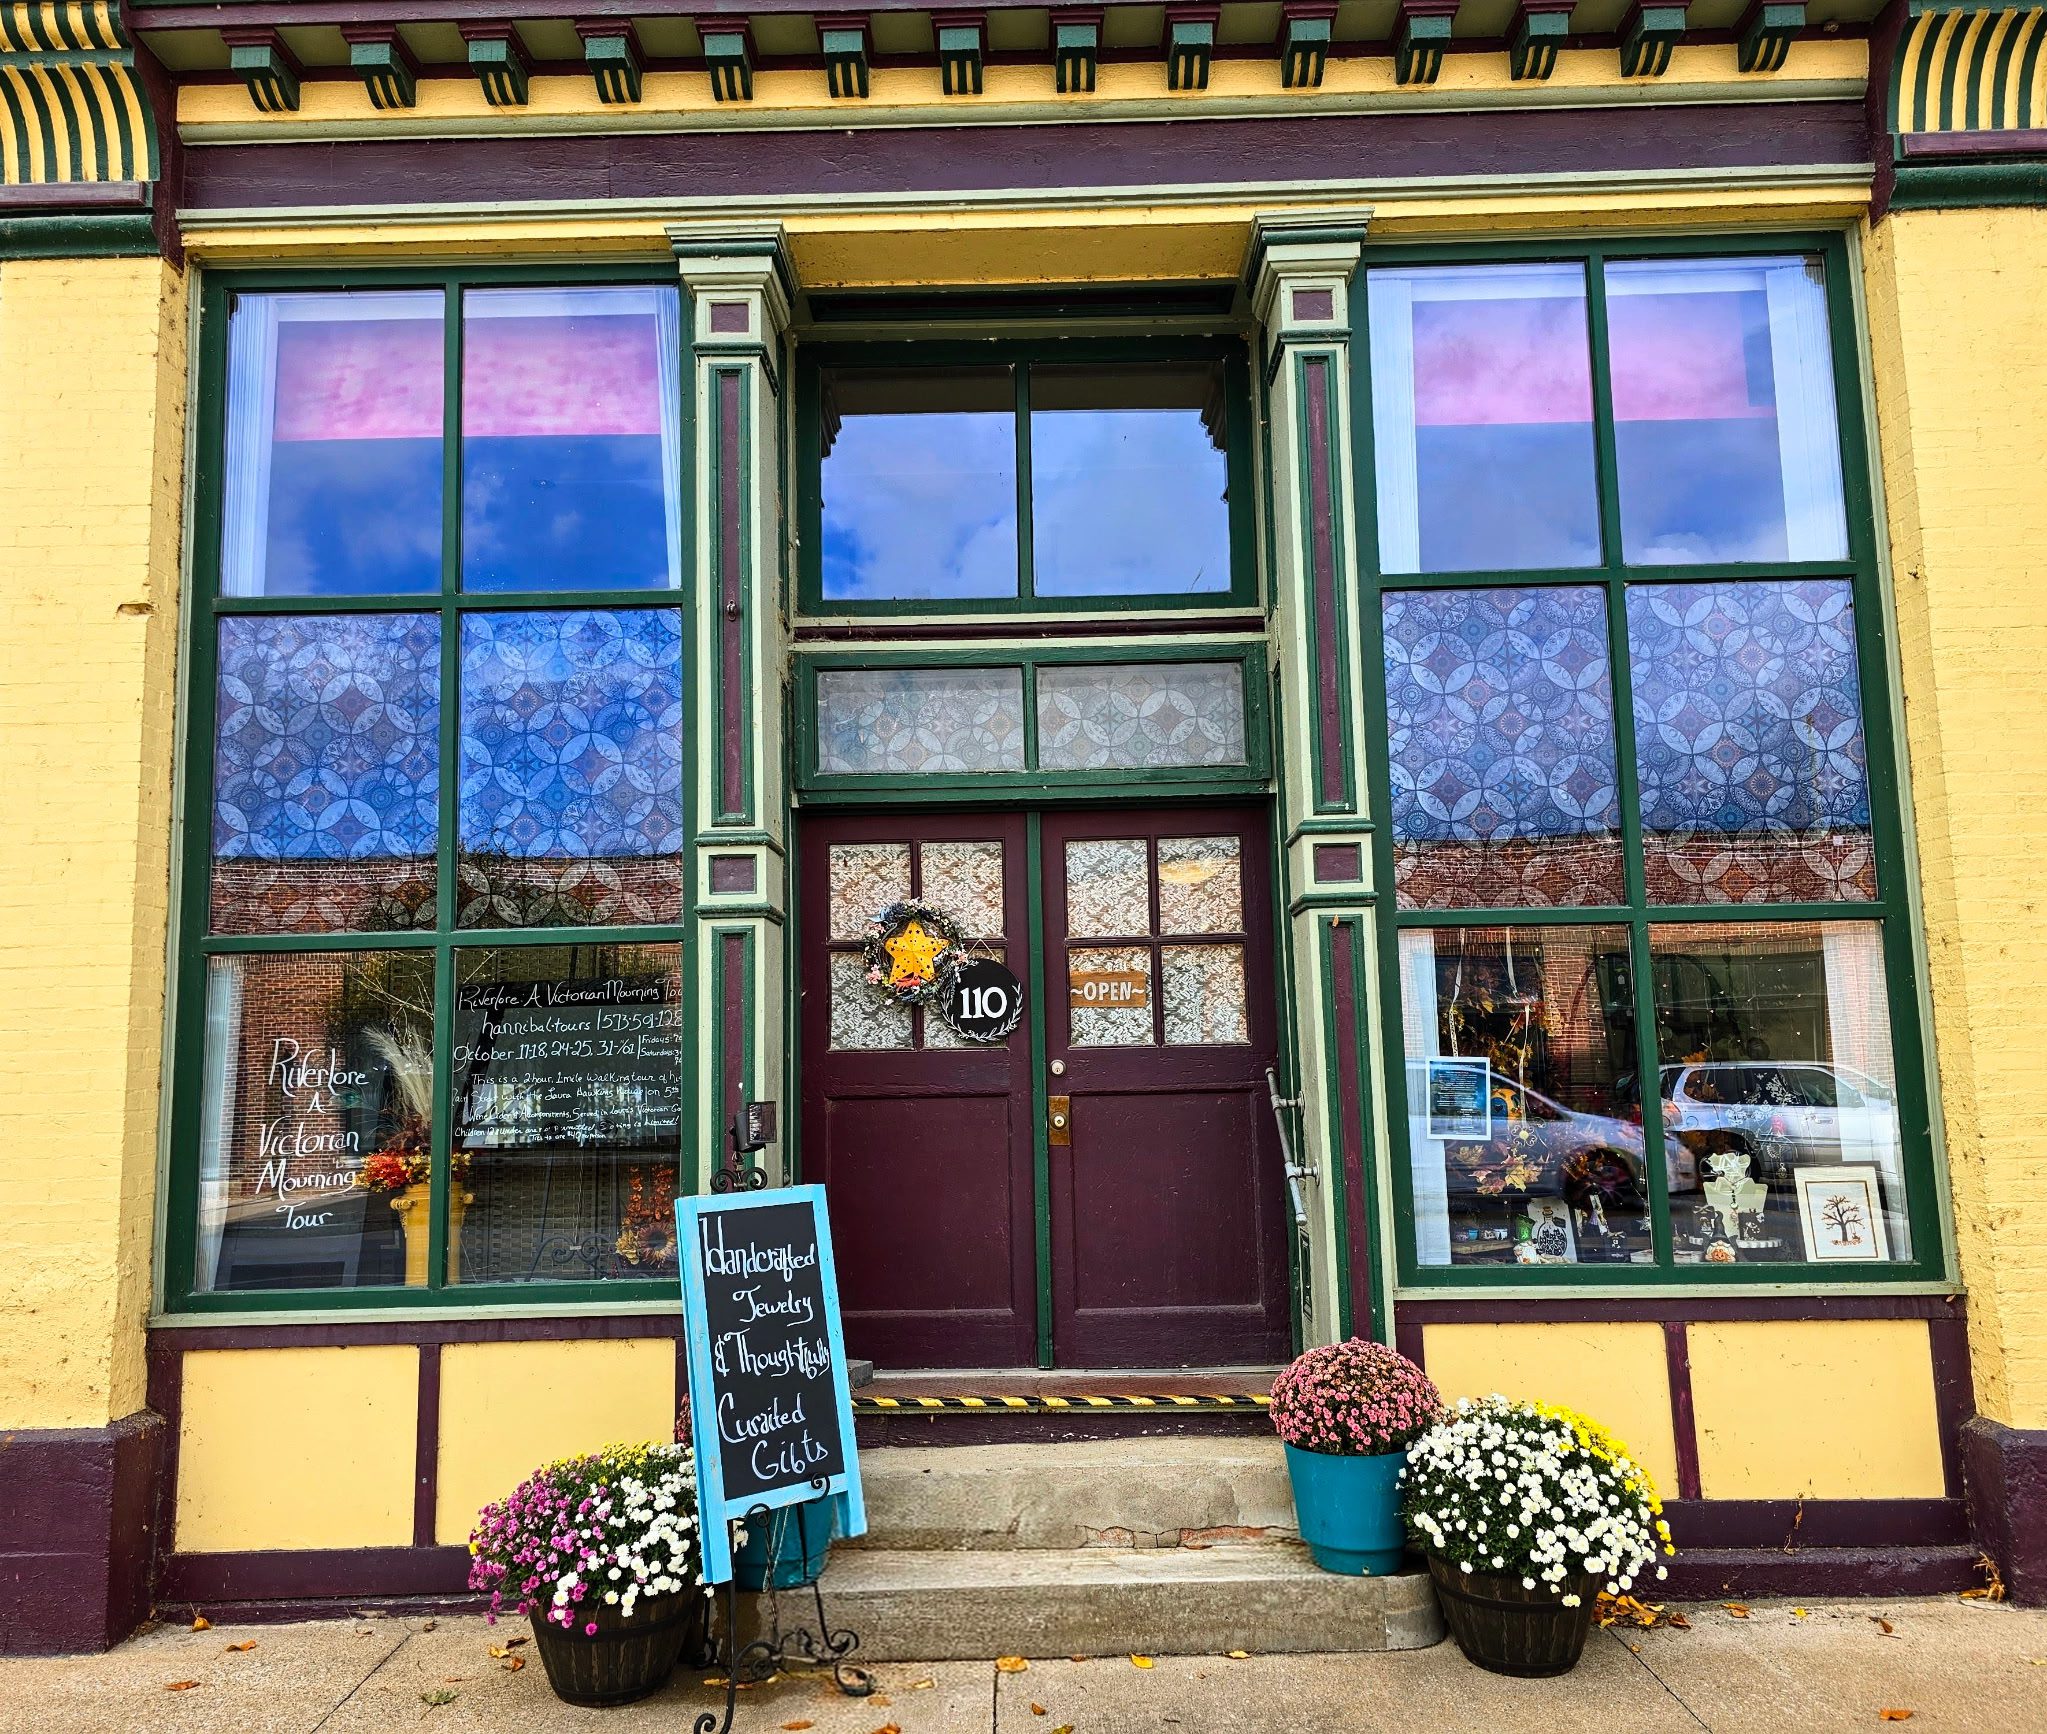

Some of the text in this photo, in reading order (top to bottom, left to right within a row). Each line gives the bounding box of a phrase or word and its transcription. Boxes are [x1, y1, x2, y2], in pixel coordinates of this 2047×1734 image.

[523, 983, 543, 1009] A
[547, 980, 605, 1006] Victorian
[603, 979, 660, 1003] Mourning
[960, 986, 1008, 1019] 110
[1083, 981, 1133, 1001] OPEN
[268, 1037, 370, 1098] Riverlore
[453, 1042, 515, 1072] October
[471, 1073, 495, 1086] This
[498, 1076, 508, 1084] is
[631, 1071, 657, 1082] tour
[658, 1075, 668, 1085] of
[501, 1092, 525, 1101] with
[544, 1086, 571, 1101] Laura
[576, 1086, 613, 1099] Hawkins
[647, 1089, 661, 1097] on
[663, 1086, 680, 1098] 5th
[306, 1091, 327, 1114] A
[259, 1115, 359, 1158] Victorian
[255, 1158, 357, 1201] Mourning
[275, 1201, 334, 1230] Tour
[698, 1215, 815, 1283] Handcrafted
[732, 1284, 814, 1327] Jewelry
[723, 1327, 830, 1380] Thoughtfully
[752, 1429, 829, 1480] Gifts
